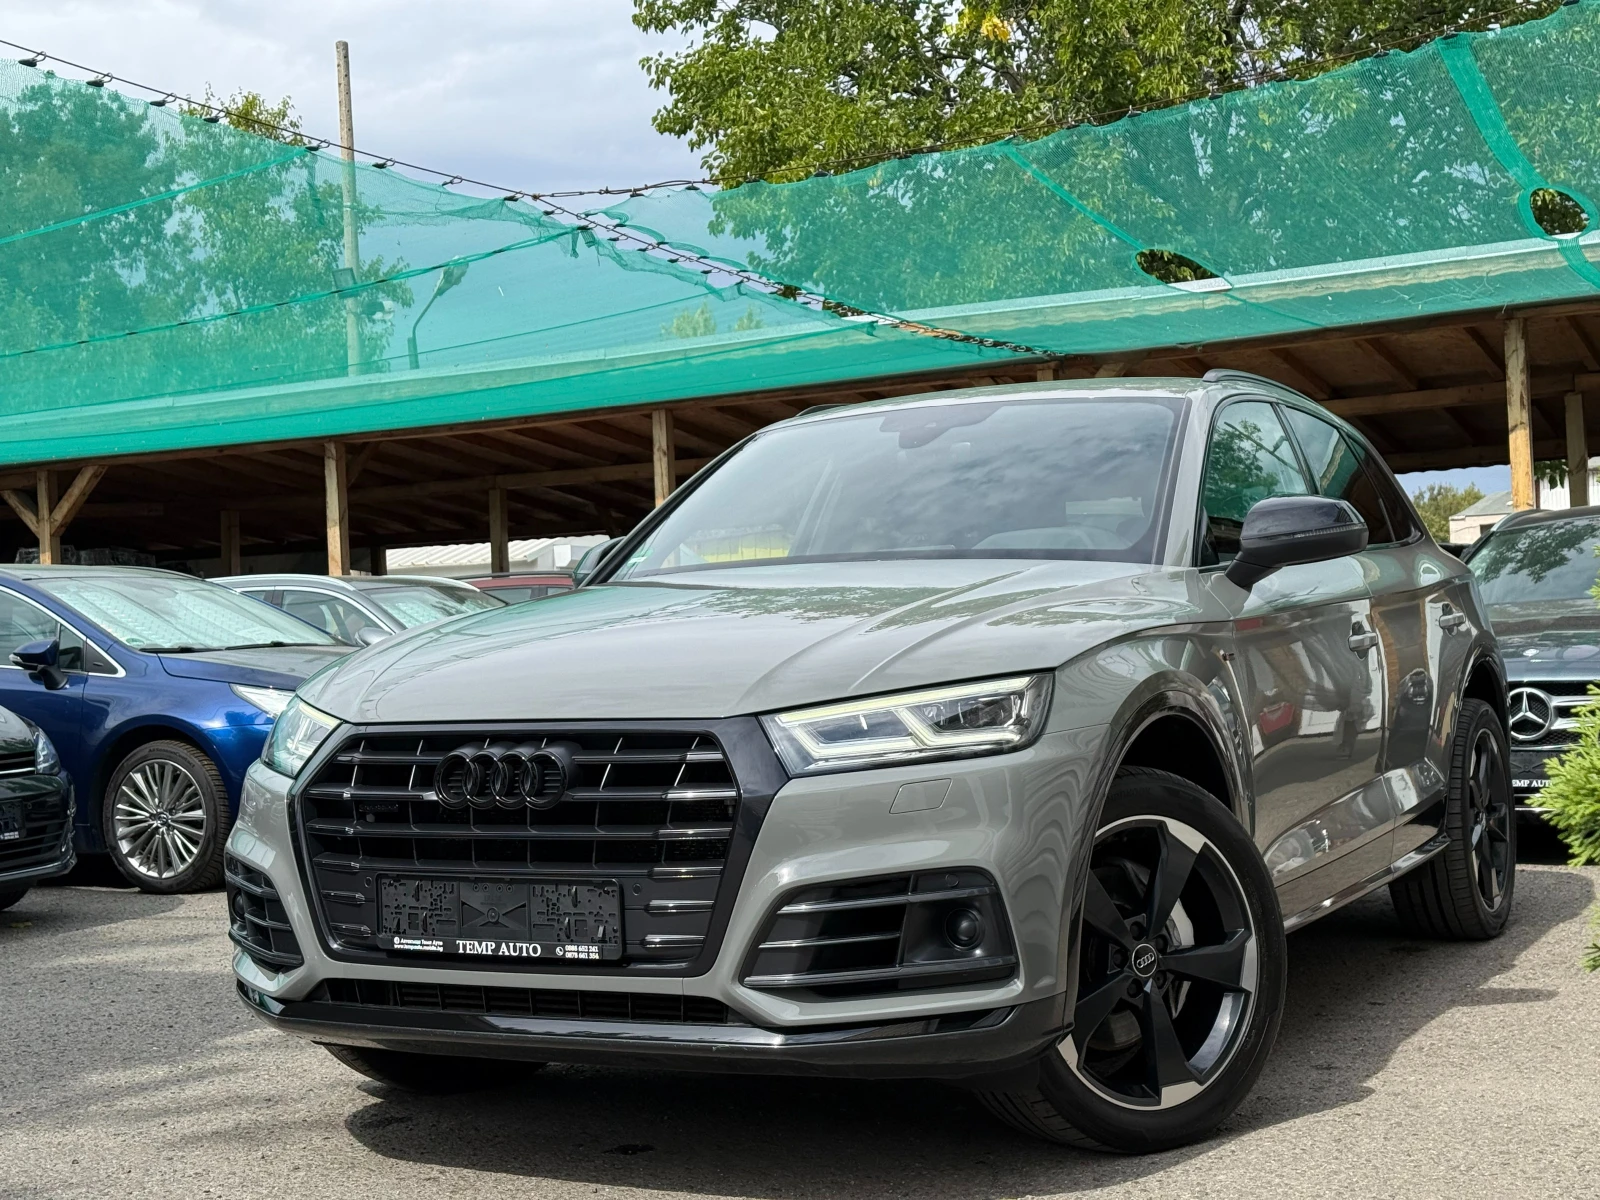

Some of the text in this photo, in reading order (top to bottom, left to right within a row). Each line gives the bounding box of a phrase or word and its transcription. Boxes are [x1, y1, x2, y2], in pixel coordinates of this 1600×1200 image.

[1511, 779, 1530, 788] EMP
[456, 940, 542, 957] TEMP AUTO
